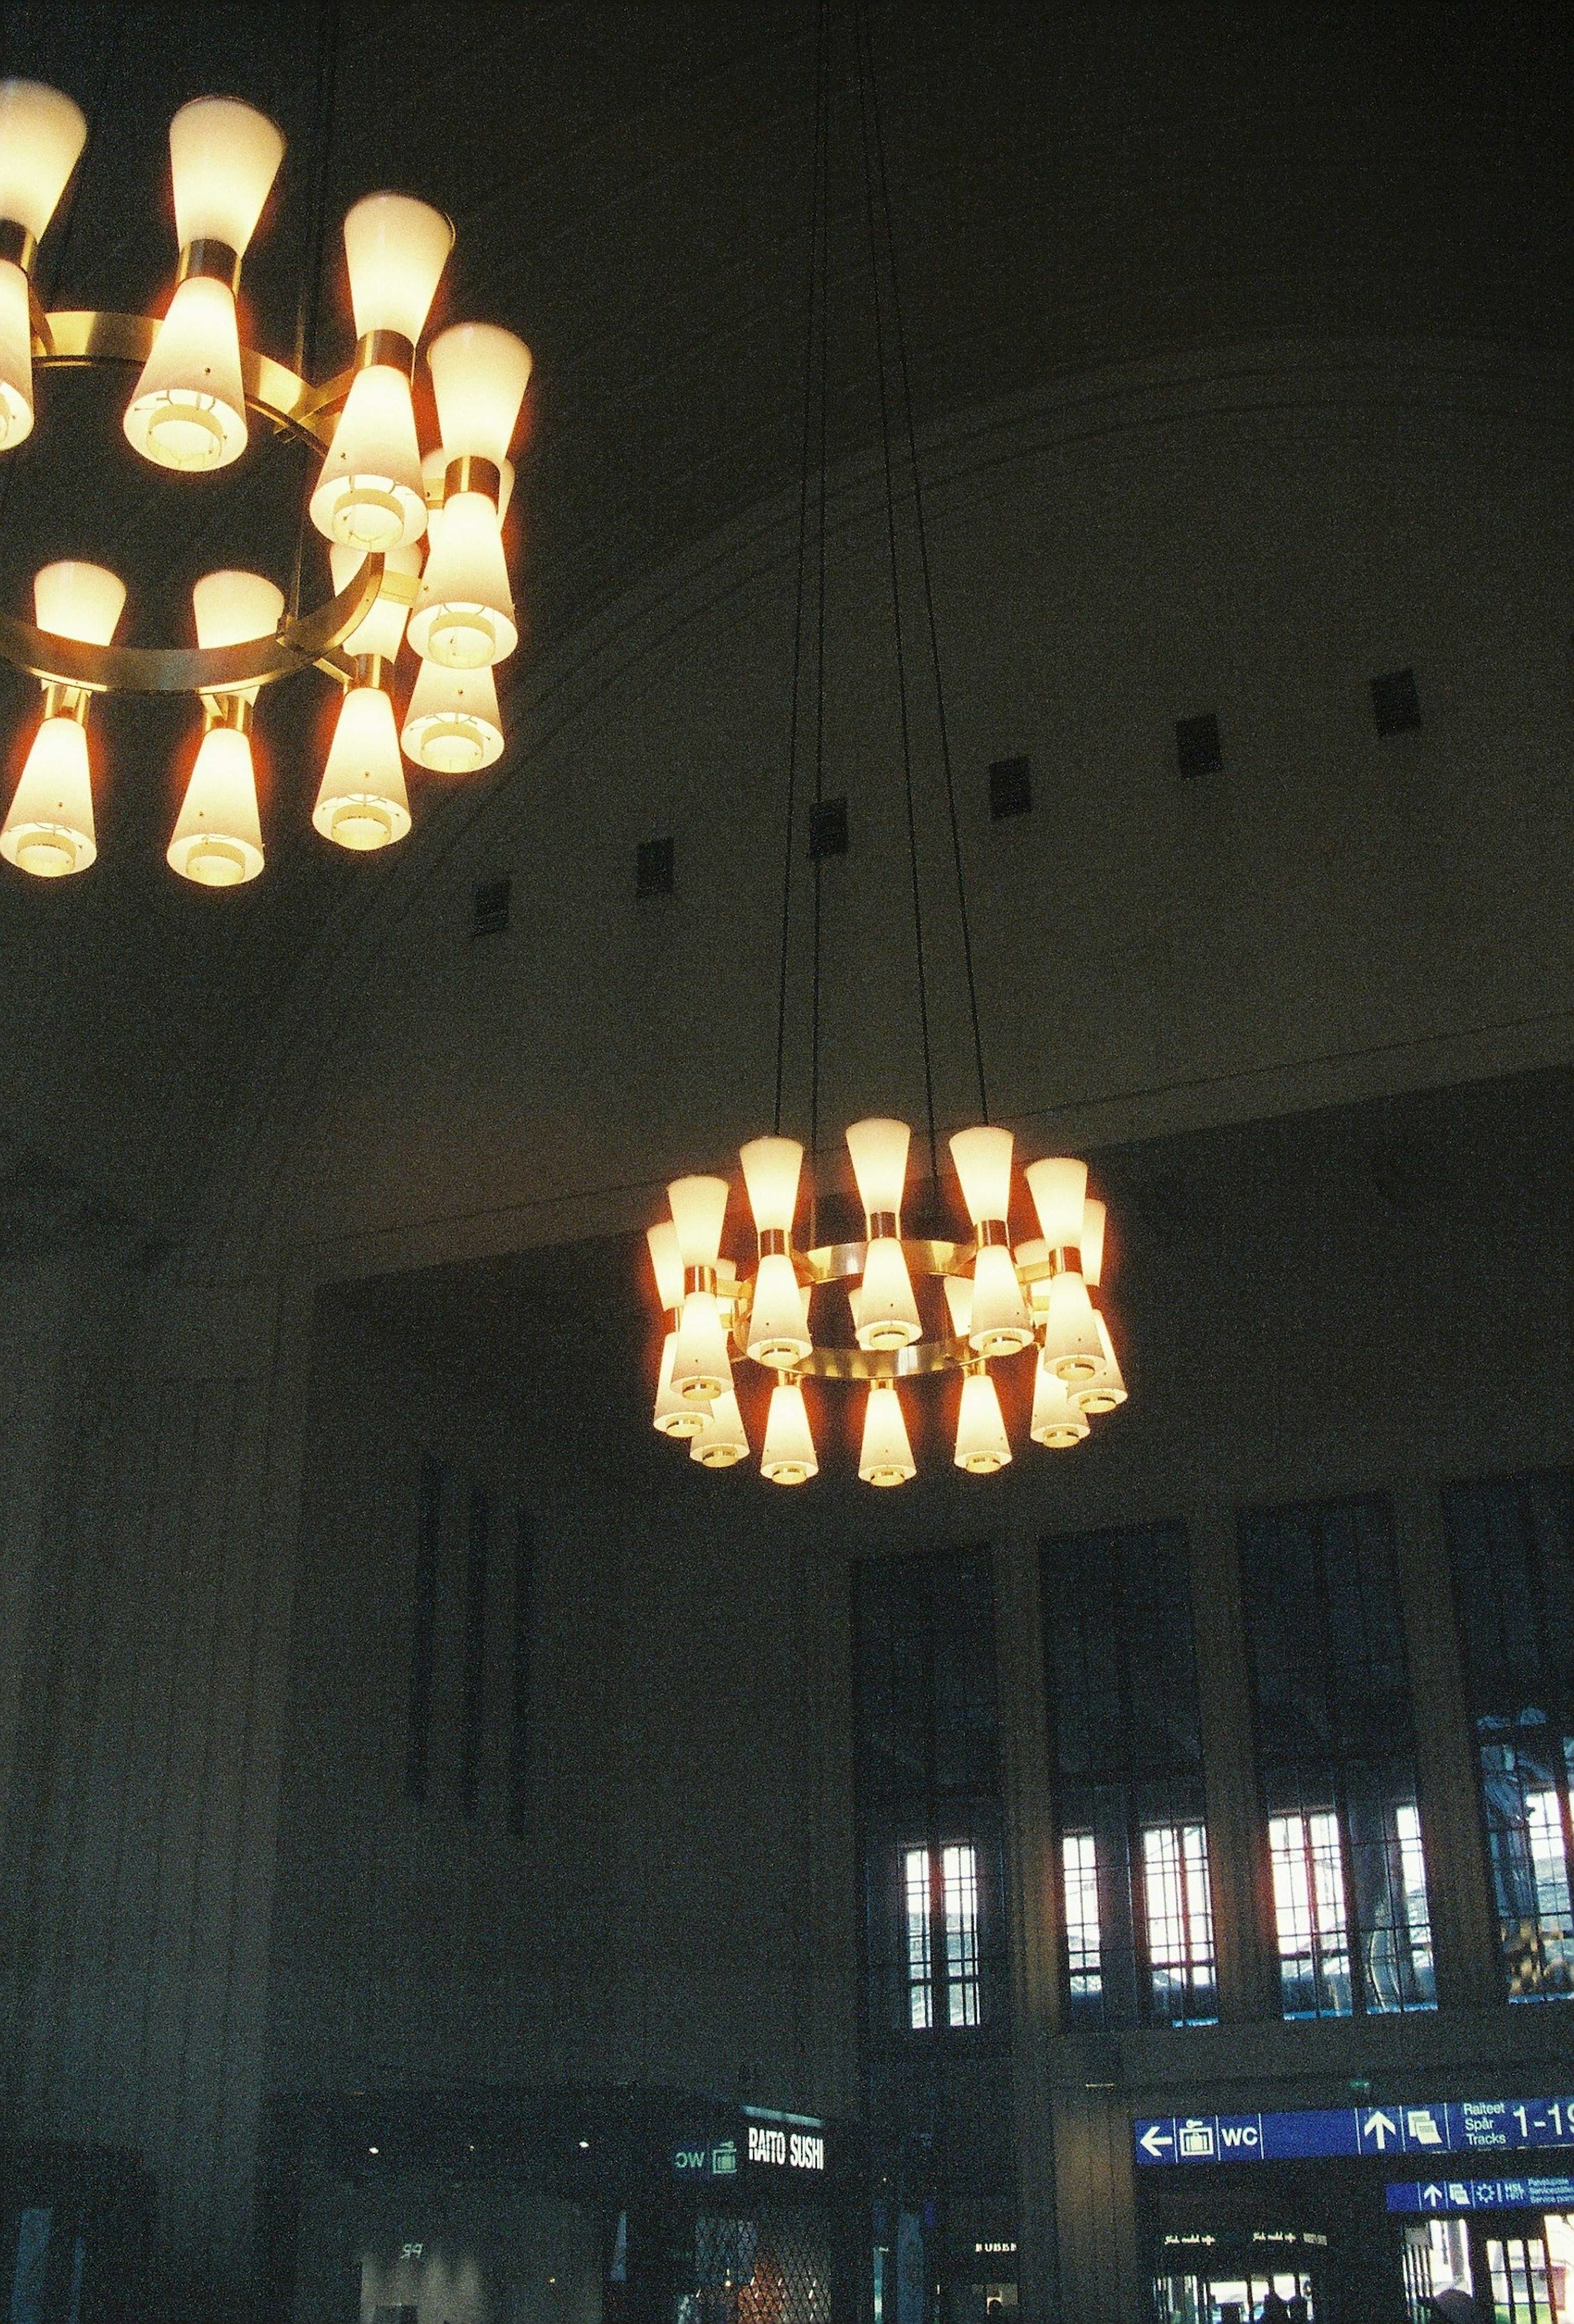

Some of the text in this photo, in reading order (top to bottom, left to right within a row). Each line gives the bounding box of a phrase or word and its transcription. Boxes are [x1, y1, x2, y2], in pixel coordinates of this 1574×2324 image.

[1464, 2102, 1506, 2115] Raiteet
[1221, 2127, 1258, 2146] WC
[1466, 2132, 1506, 2145] Tracks
[749, 2127, 823, 2170] RAITO SUSHI
